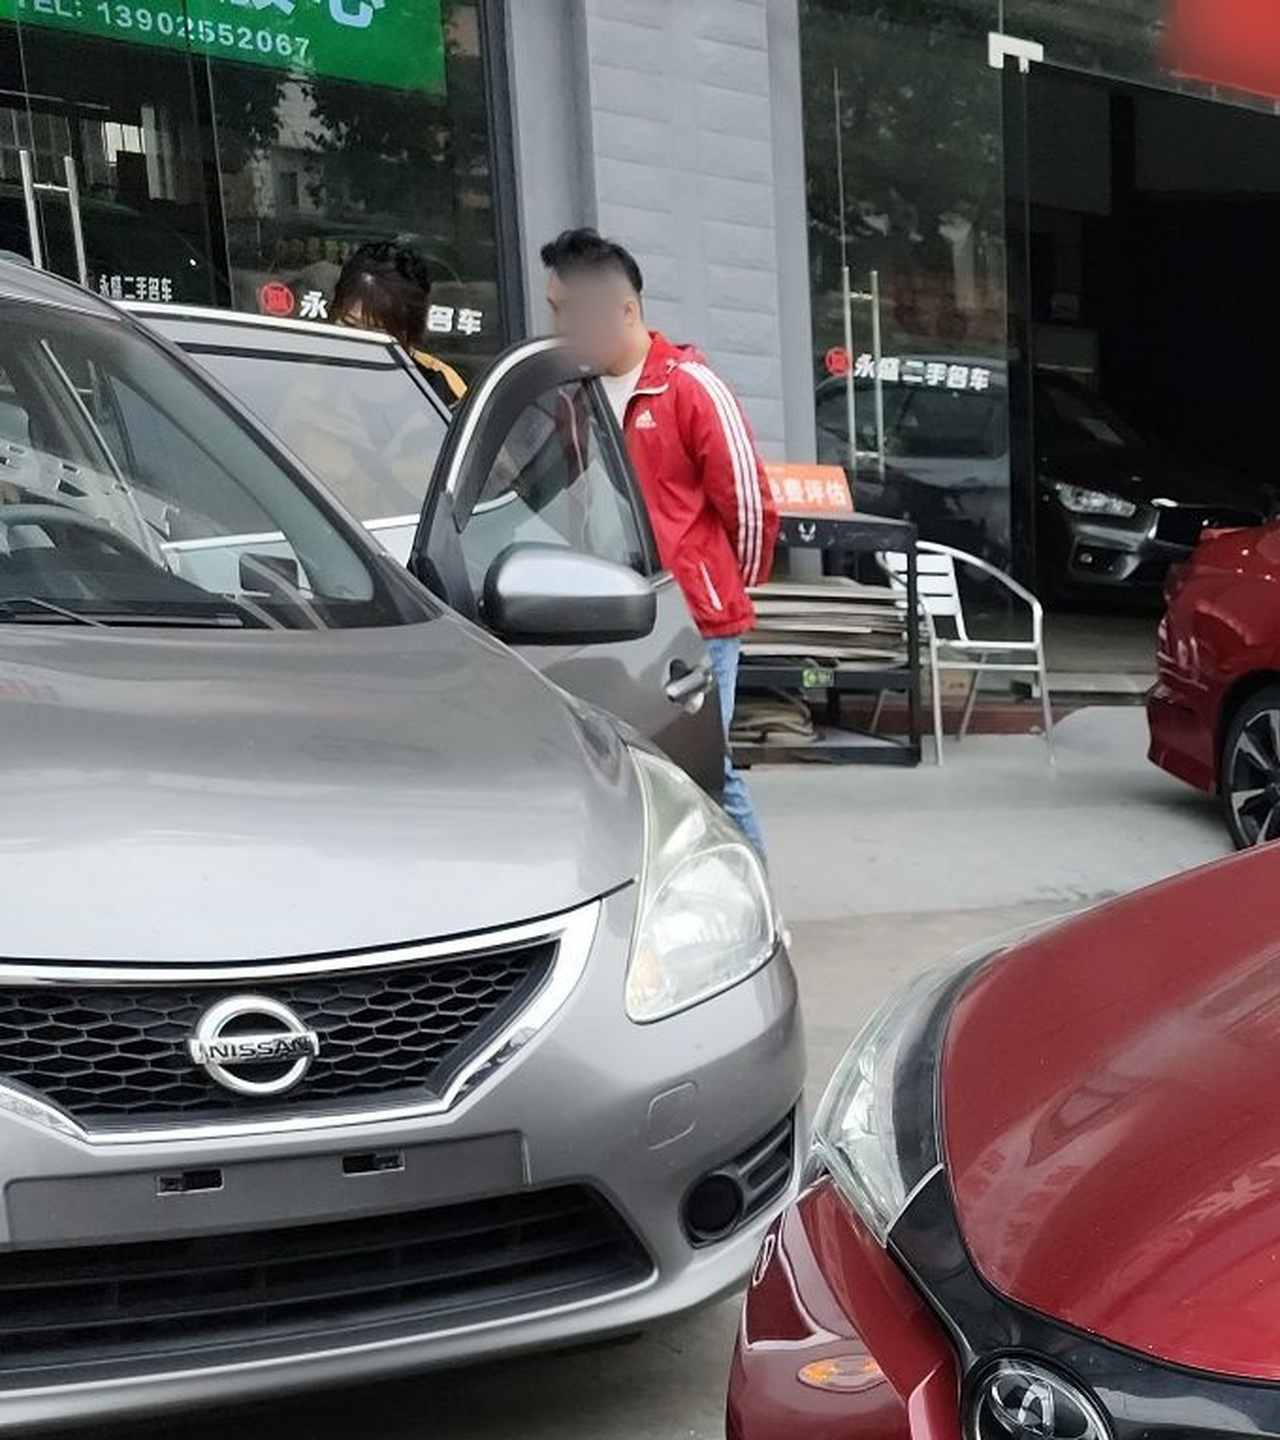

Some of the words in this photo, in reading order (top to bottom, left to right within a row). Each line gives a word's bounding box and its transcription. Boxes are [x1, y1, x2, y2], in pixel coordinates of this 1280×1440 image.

[97, 4, 310, 57] 13902552067
[854, 353, 991, 391] 永盛二手名车
[209, 1035, 313, 1060] NISSAN
